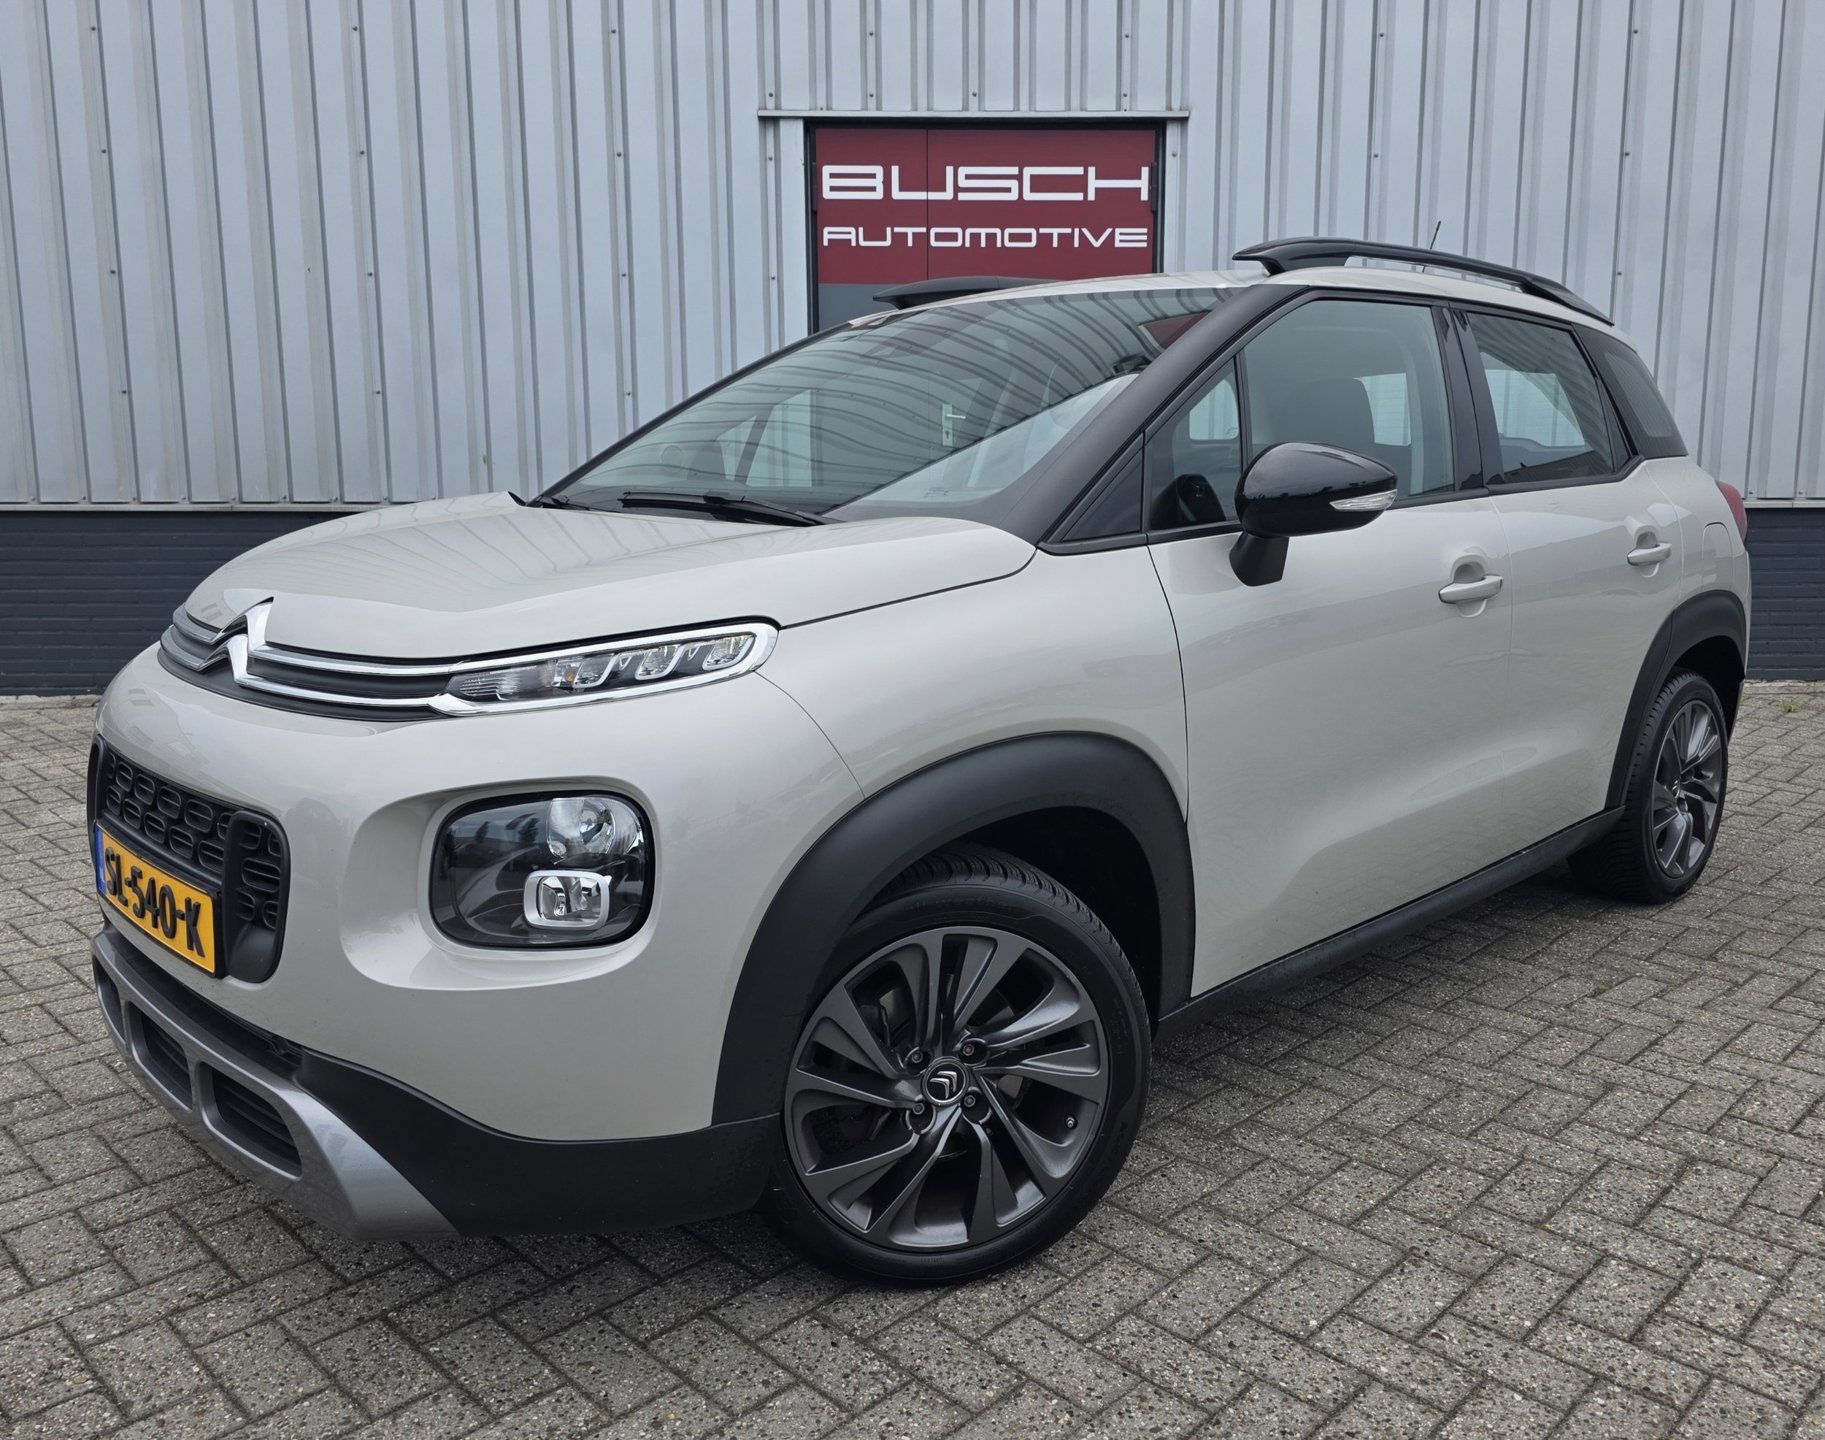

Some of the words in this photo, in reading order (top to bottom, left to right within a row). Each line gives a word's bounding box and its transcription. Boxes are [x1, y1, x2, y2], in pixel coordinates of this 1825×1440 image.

[821, 165, 1149, 201] BUSCH
[822, 226, 1148, 248] AUTOMOTIVE
[104, 846, 206, 958] SL-540-K
